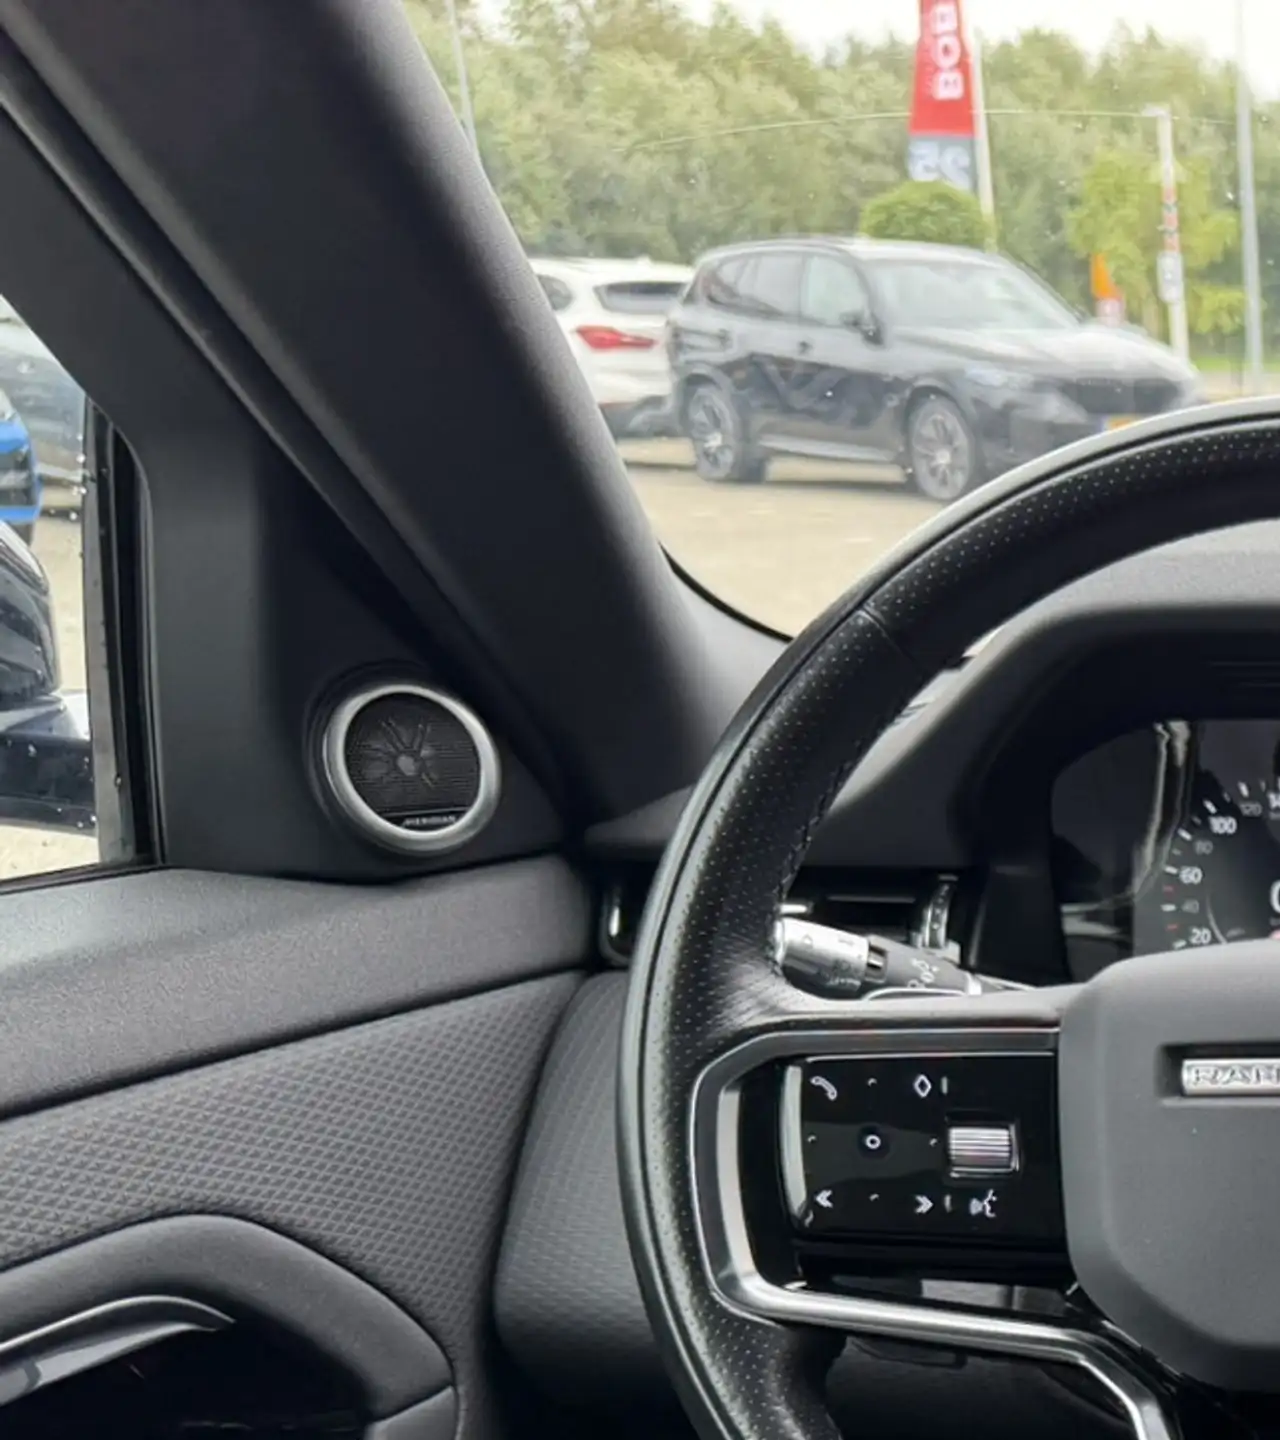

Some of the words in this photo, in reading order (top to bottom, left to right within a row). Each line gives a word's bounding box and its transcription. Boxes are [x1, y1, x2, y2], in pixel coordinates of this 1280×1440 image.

[1209, 816, 1237, 835] 100
[1180, 866, 1203, 884] 60
[1189, 928, 1211, 945] 20
